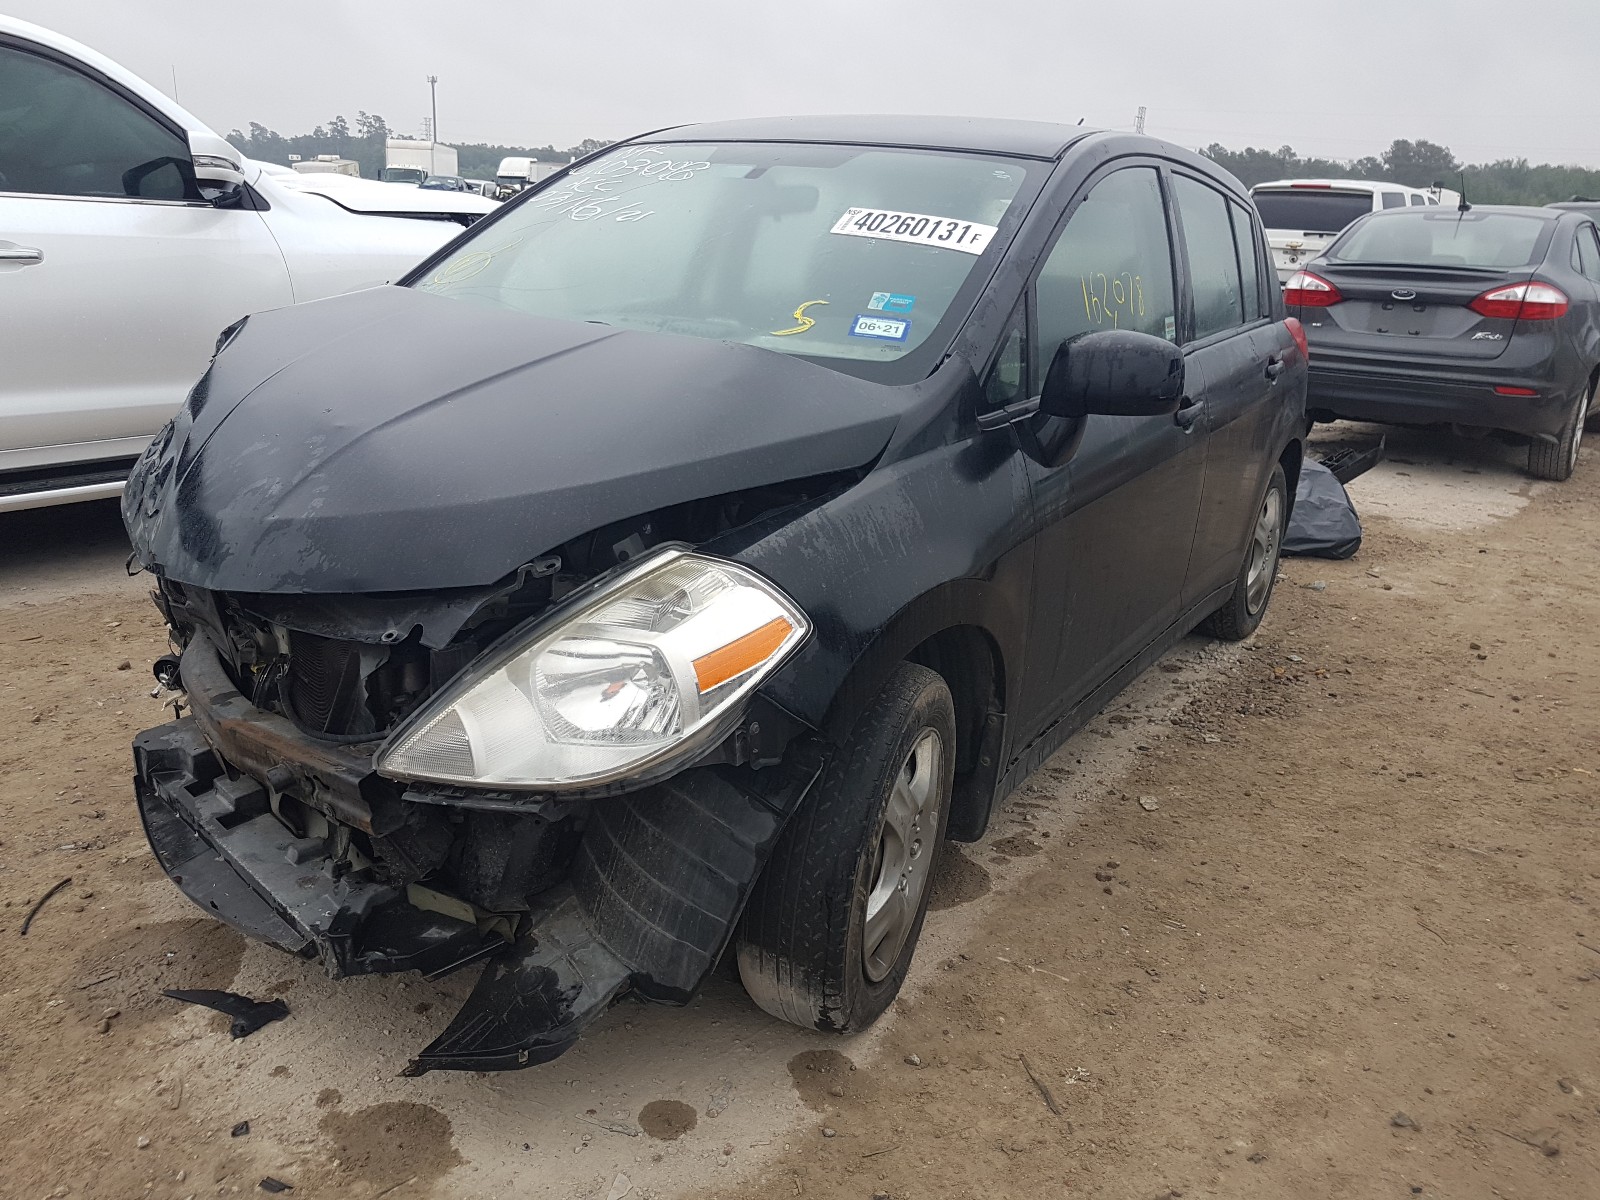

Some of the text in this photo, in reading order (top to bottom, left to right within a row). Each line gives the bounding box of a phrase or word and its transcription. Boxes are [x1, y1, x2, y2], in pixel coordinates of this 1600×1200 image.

[854, 212, 972, 243] 40260131
[969, 233, 982, 244] F
[858, 321, 877, 331] 06
[883, 324, 900, 334] 21
